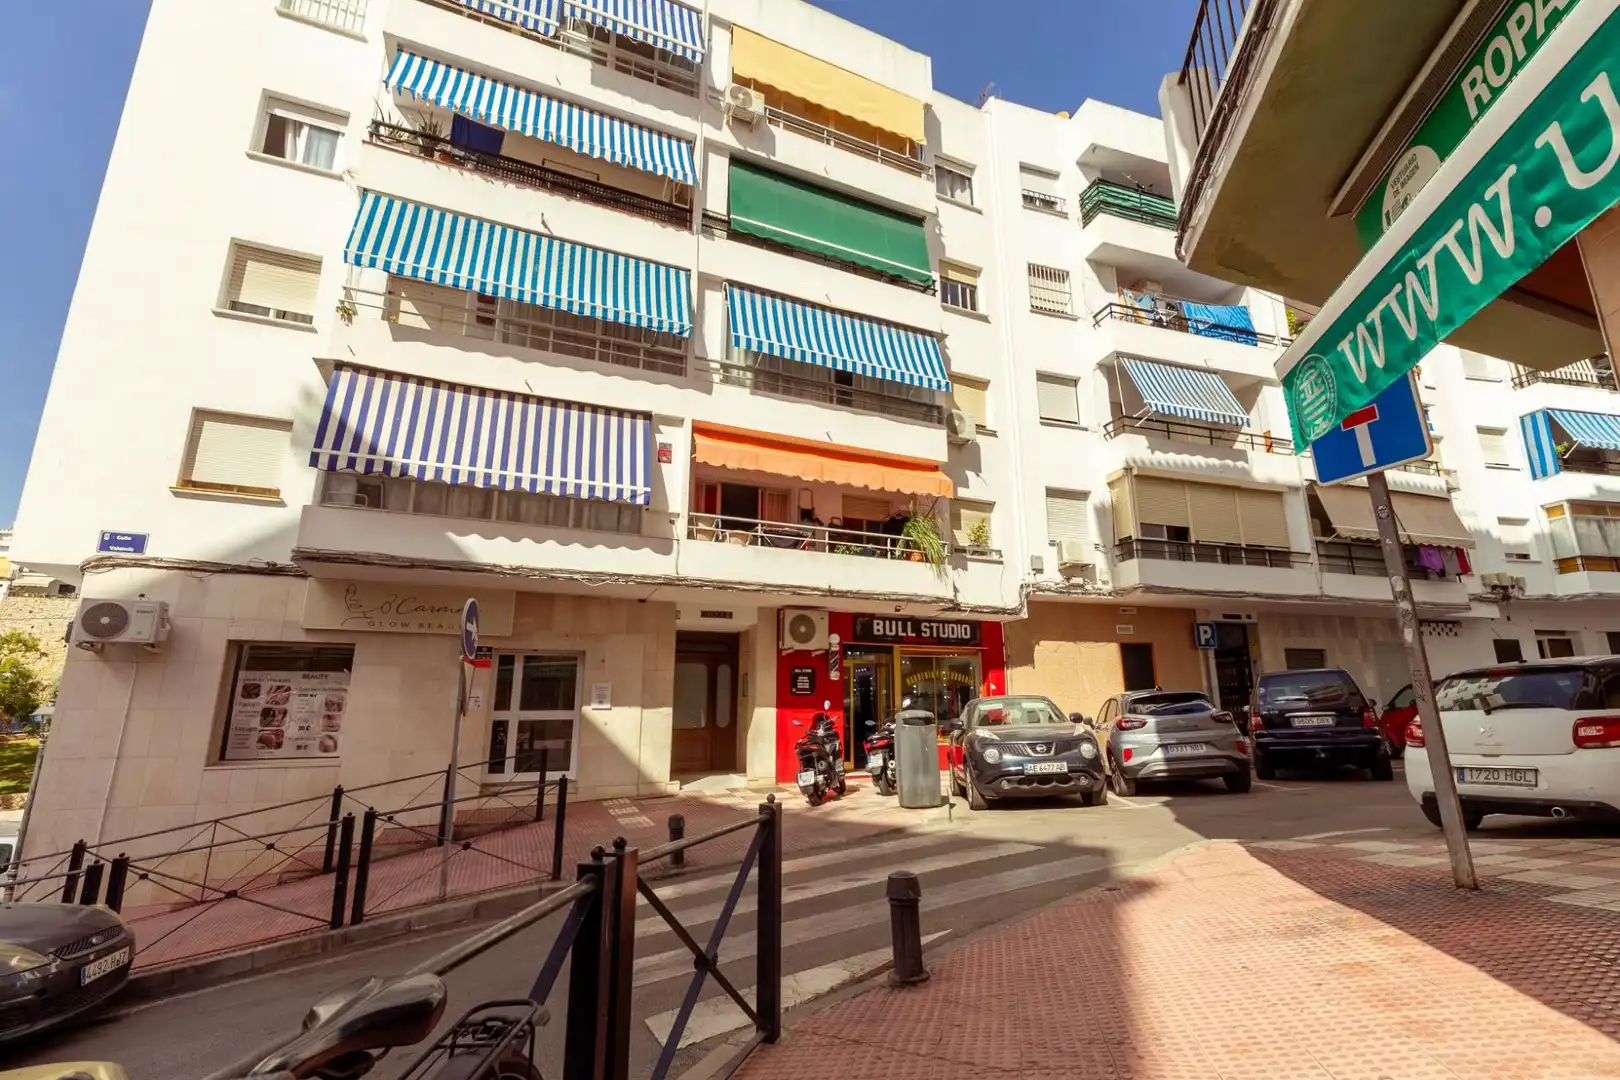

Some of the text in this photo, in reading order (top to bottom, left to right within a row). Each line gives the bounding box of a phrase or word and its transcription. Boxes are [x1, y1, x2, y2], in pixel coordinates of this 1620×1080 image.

[1391, 153, 1417, 189] VESTUARIO
[1393, 161, 1420, 198] DE IMAGEN
[368, 620, 410, 629] GLOW
[873, 620, 971, 639] BULL STUDIO
[1199, 625, 1212, 646] P
[301, 673, 330, 681] BEAUTY
[1468, 768, 1532, 783] 1720 HGL
[86, 959, 108, 979] 4492
